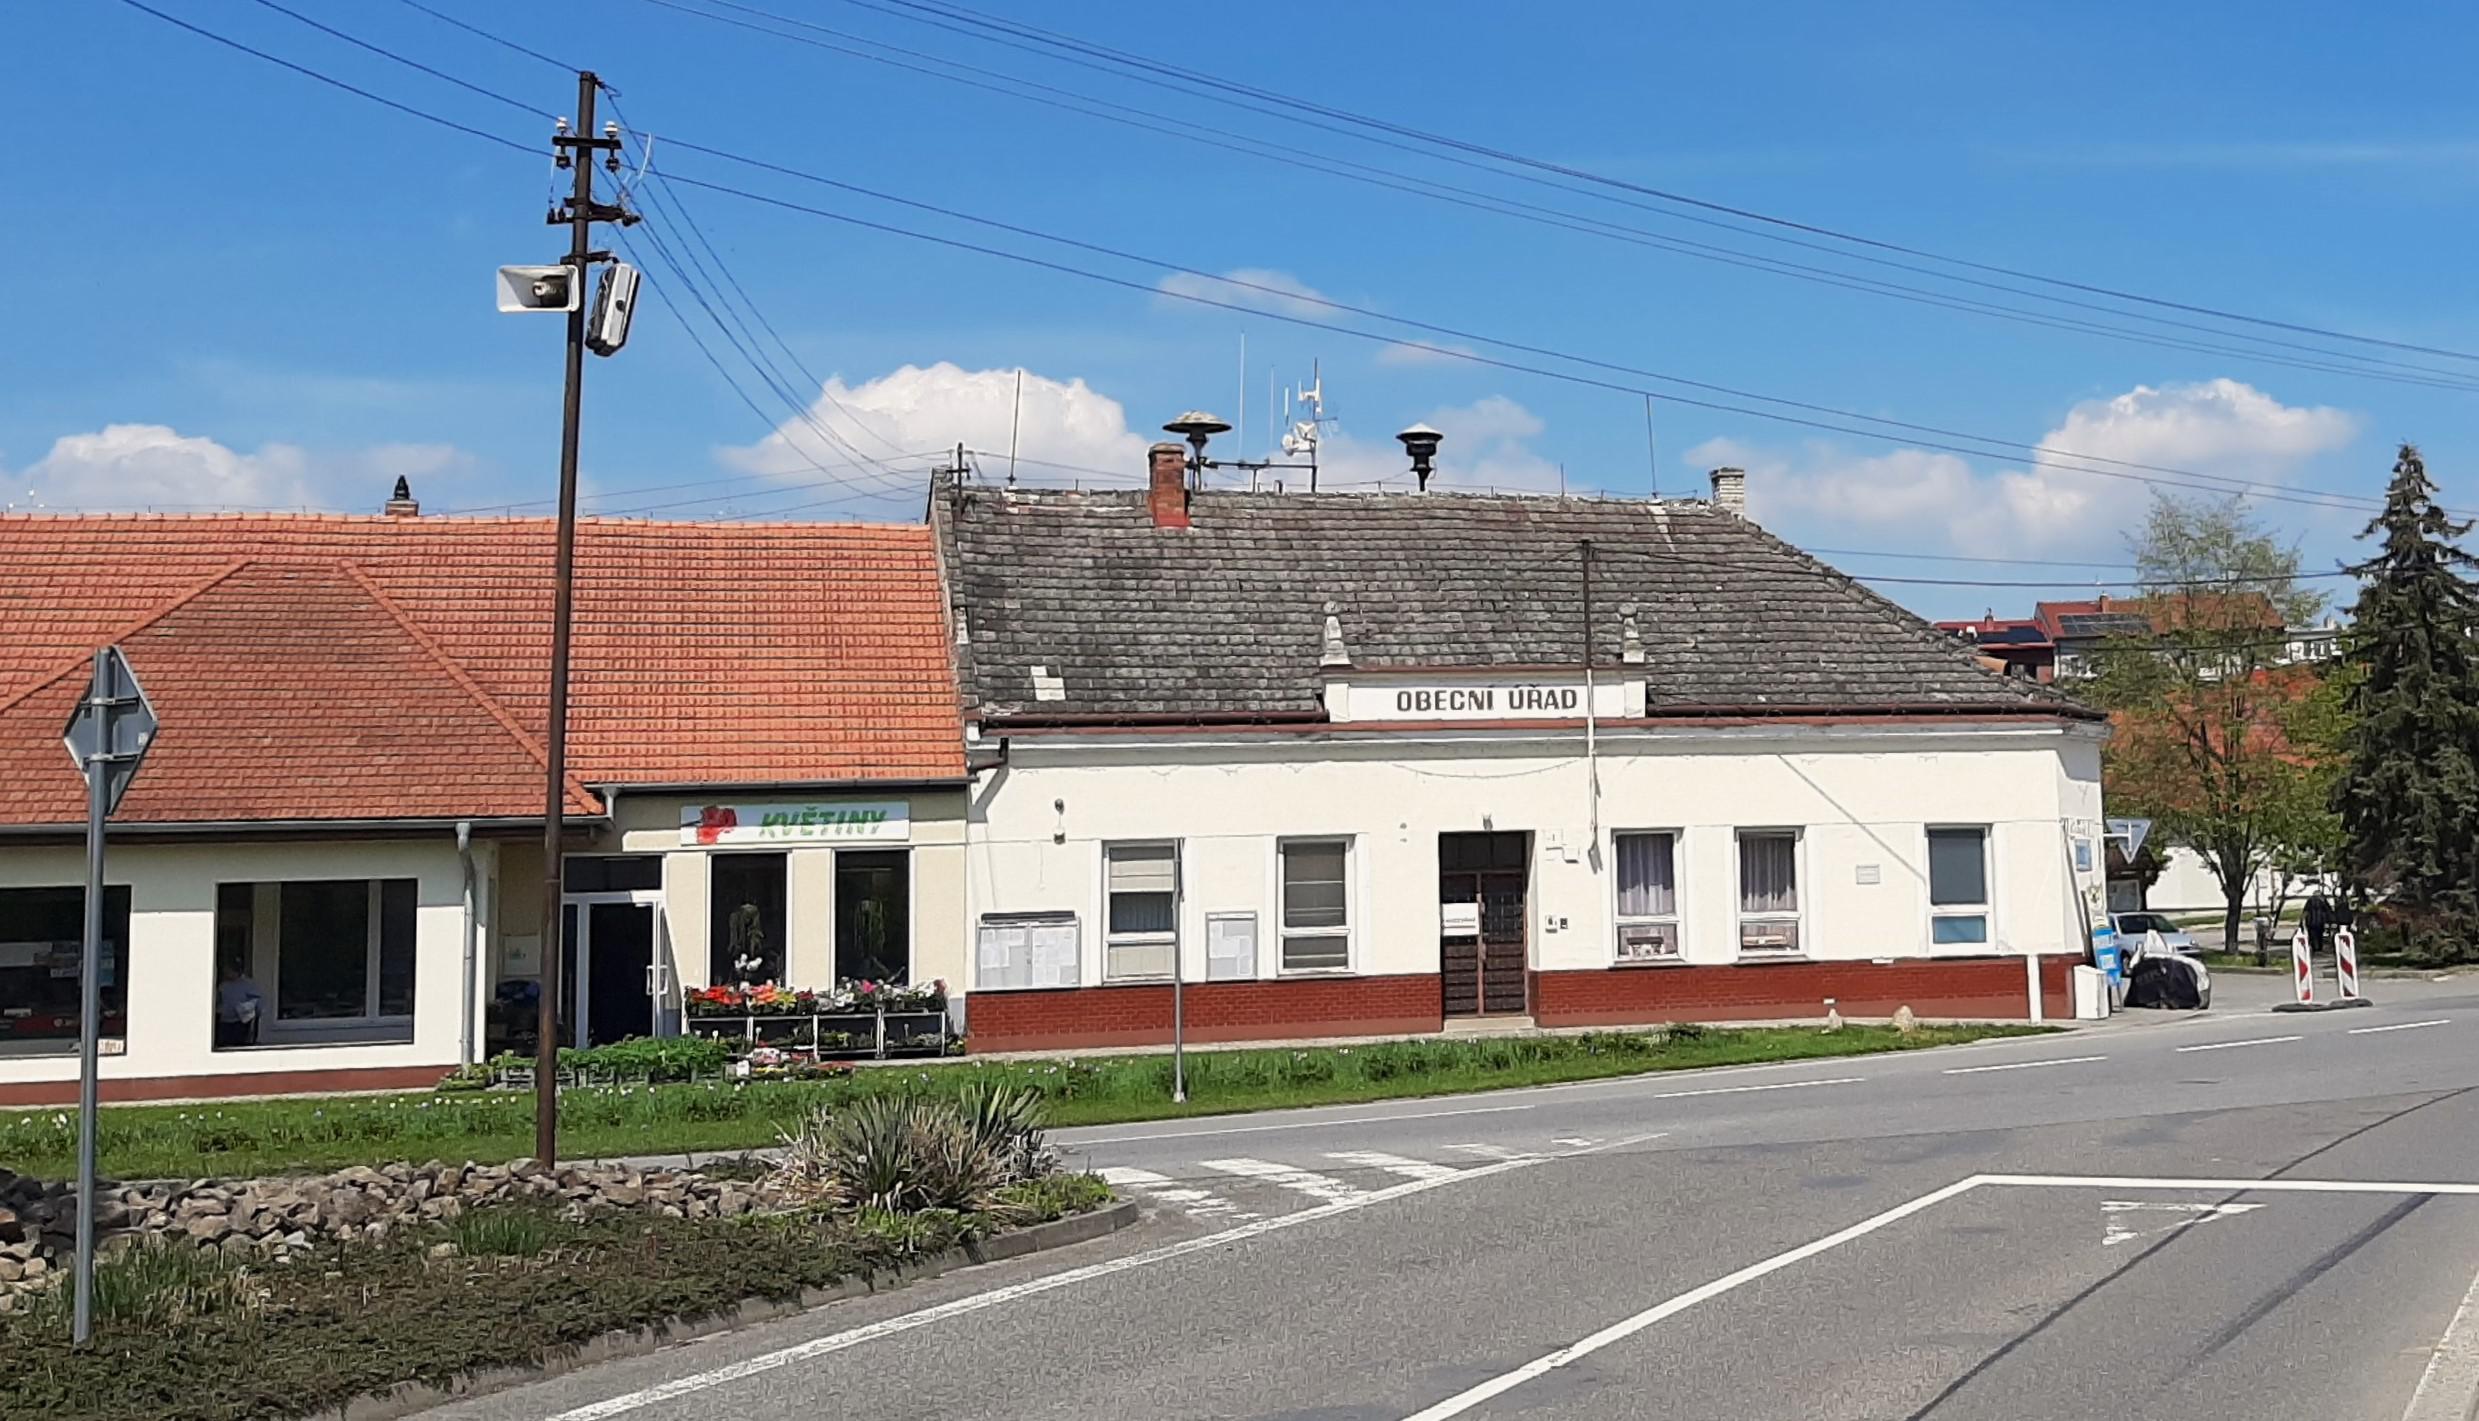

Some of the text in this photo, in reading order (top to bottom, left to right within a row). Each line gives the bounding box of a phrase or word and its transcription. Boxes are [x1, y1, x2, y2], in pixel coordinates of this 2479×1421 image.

[1397, 683, 1577, 712] OBECNÍ ÚŘAD
[759, 806, 887, 838] KVĚTINY
